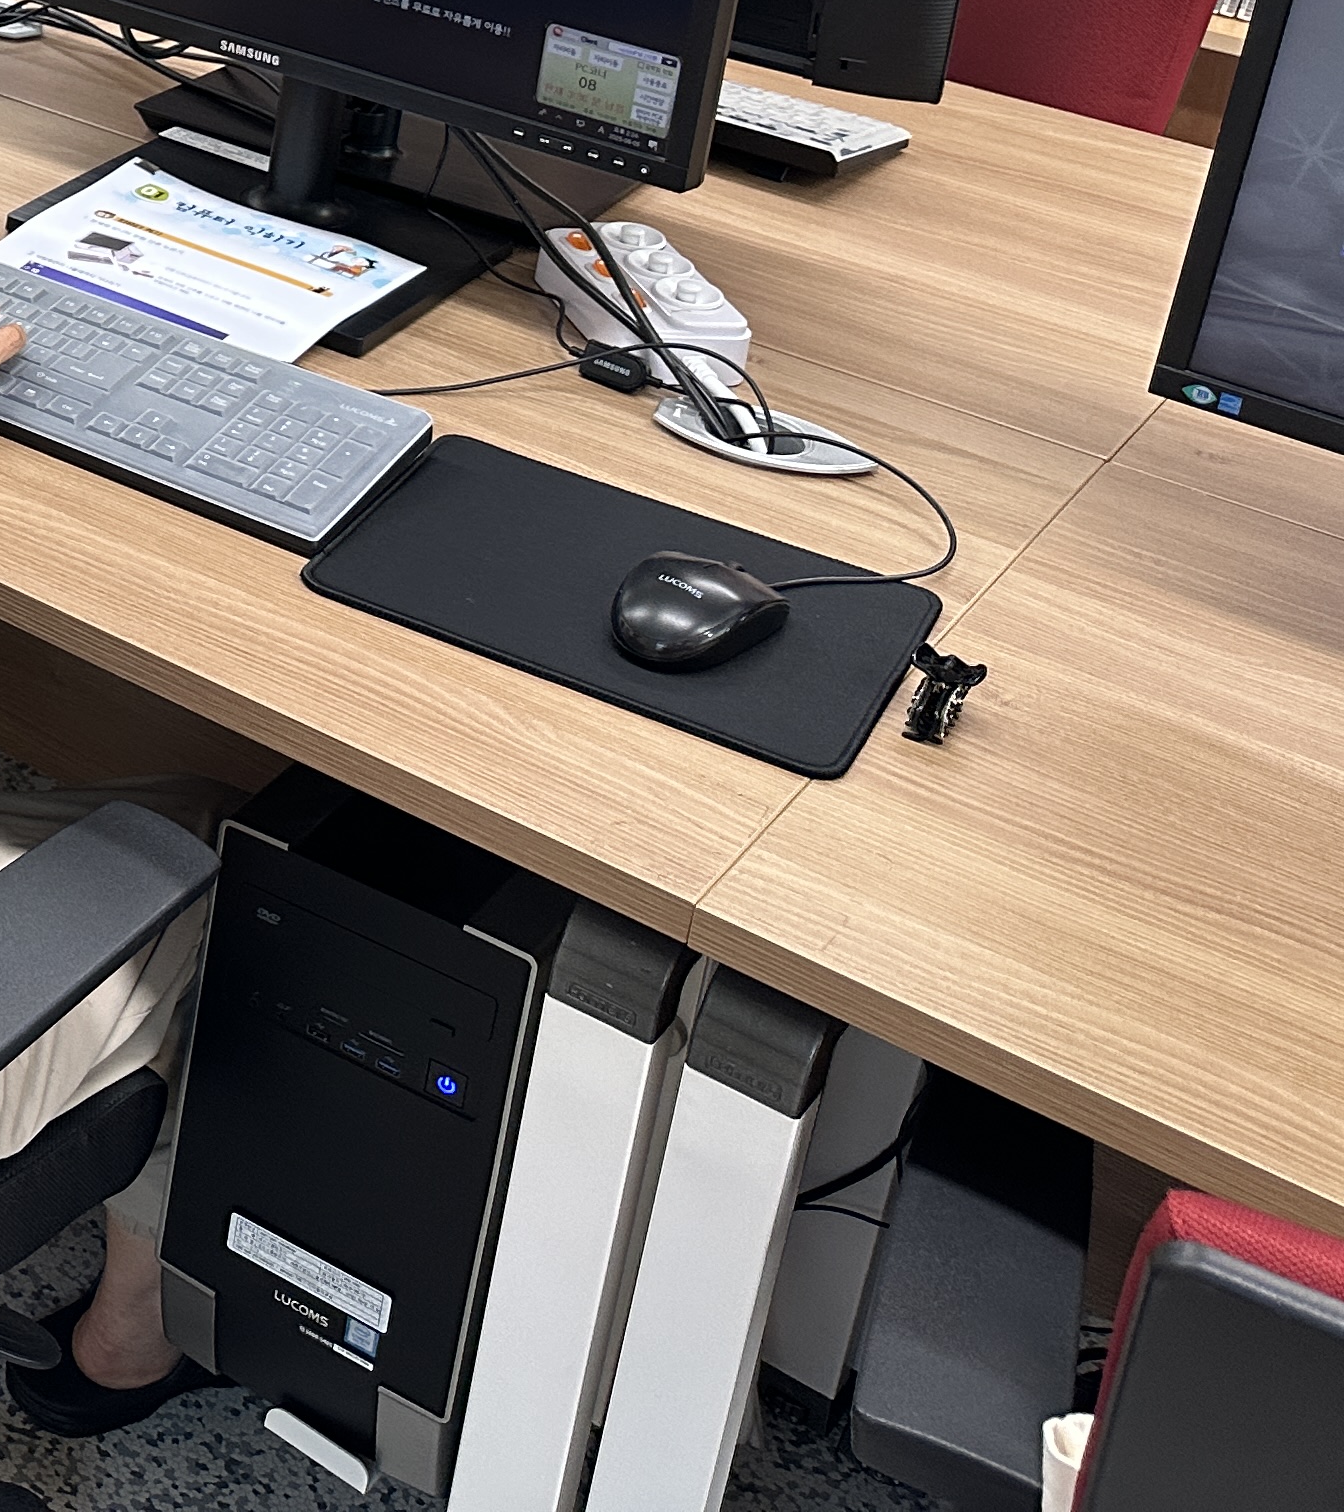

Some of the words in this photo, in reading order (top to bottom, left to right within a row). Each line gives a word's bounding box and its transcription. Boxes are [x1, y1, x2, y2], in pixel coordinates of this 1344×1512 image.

[412, 0, 441, 18] 무료로
[443, 9, 482, 30] 자유롭게
[484, 21, 512, 38] 이용!!
[219, 40, 280, 66] SAMSUNG
[578, 76, 597, 91] 08
[140, 186, 164, 199] 01
[175, 201, 236, 226] 컴퓨터
[658, 574, 704, 599] LUCOMS
[273, 1289, 330, 1328] LUCOMS
